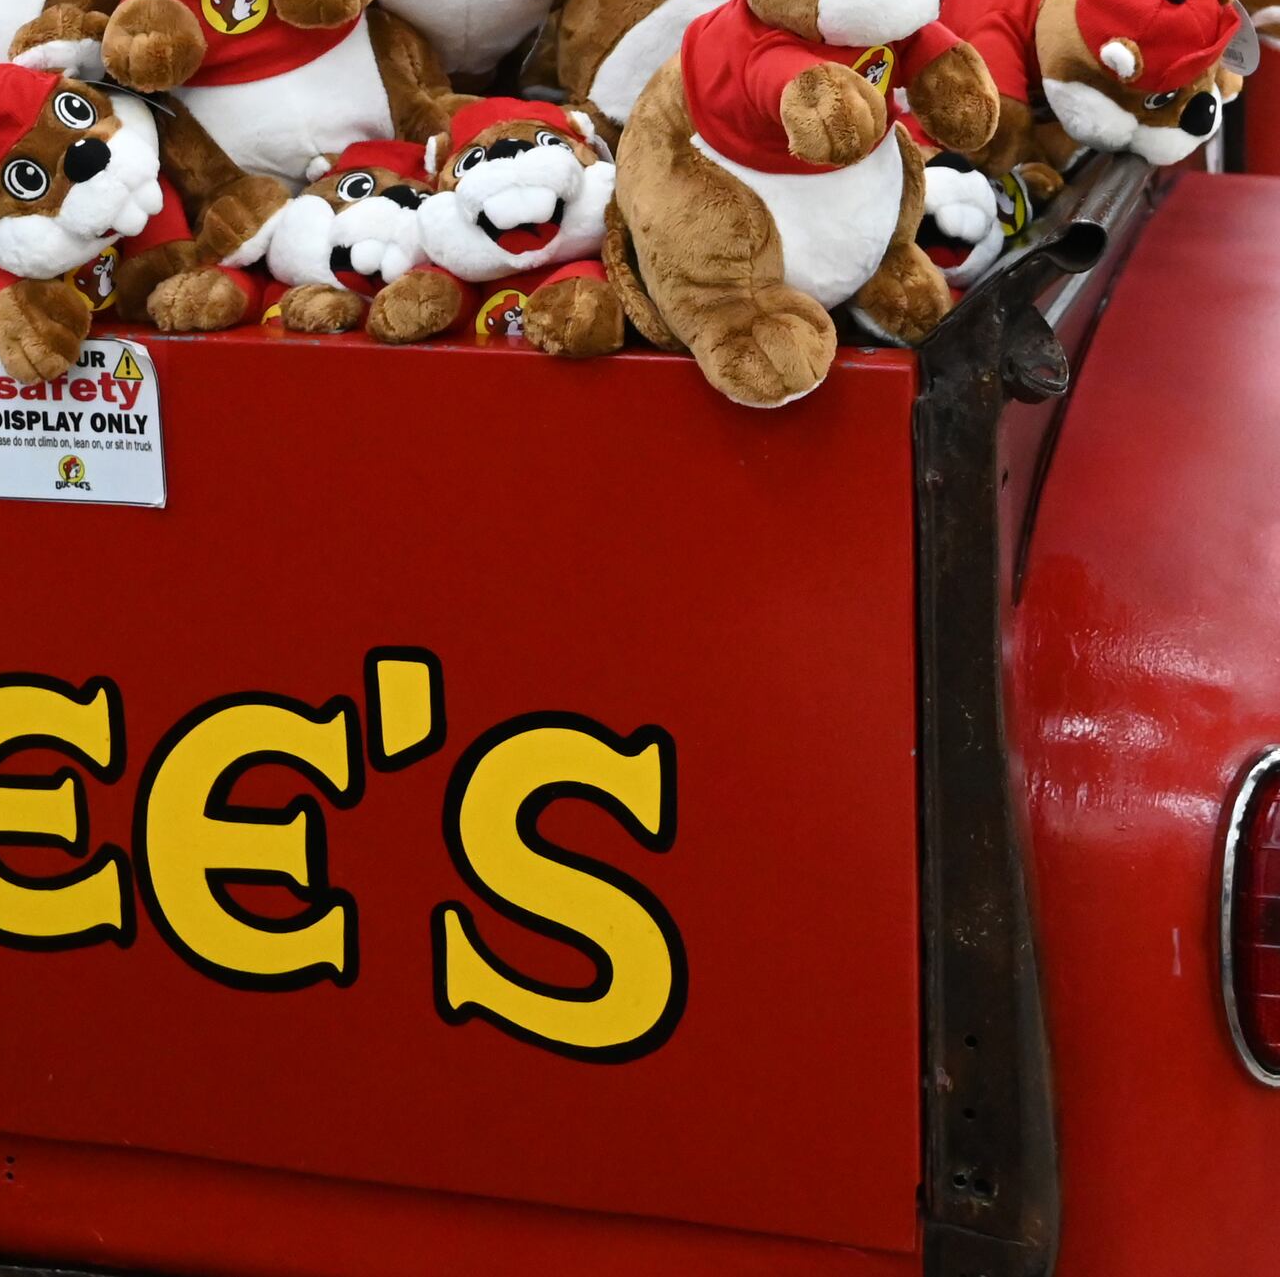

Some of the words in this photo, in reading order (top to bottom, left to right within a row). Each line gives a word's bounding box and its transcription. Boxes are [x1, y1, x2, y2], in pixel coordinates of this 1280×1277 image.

[75, 351, 106, 368] UR
[90, 412, 148, 435] ONLY
[13, 436, 23, 446] do
[24, 437, 37, 447] not
[38, 436, 58, 448] climb
[60, 439, 72, 449] on,
[73, 437, 90, 449] lean
[92, 440, 104, 451] on,
[105, 440, 113, 450] or
[115, 439, 124, 451] sit
[125, 439, 132, 451] in
[134, 441, 153, 452] truck
